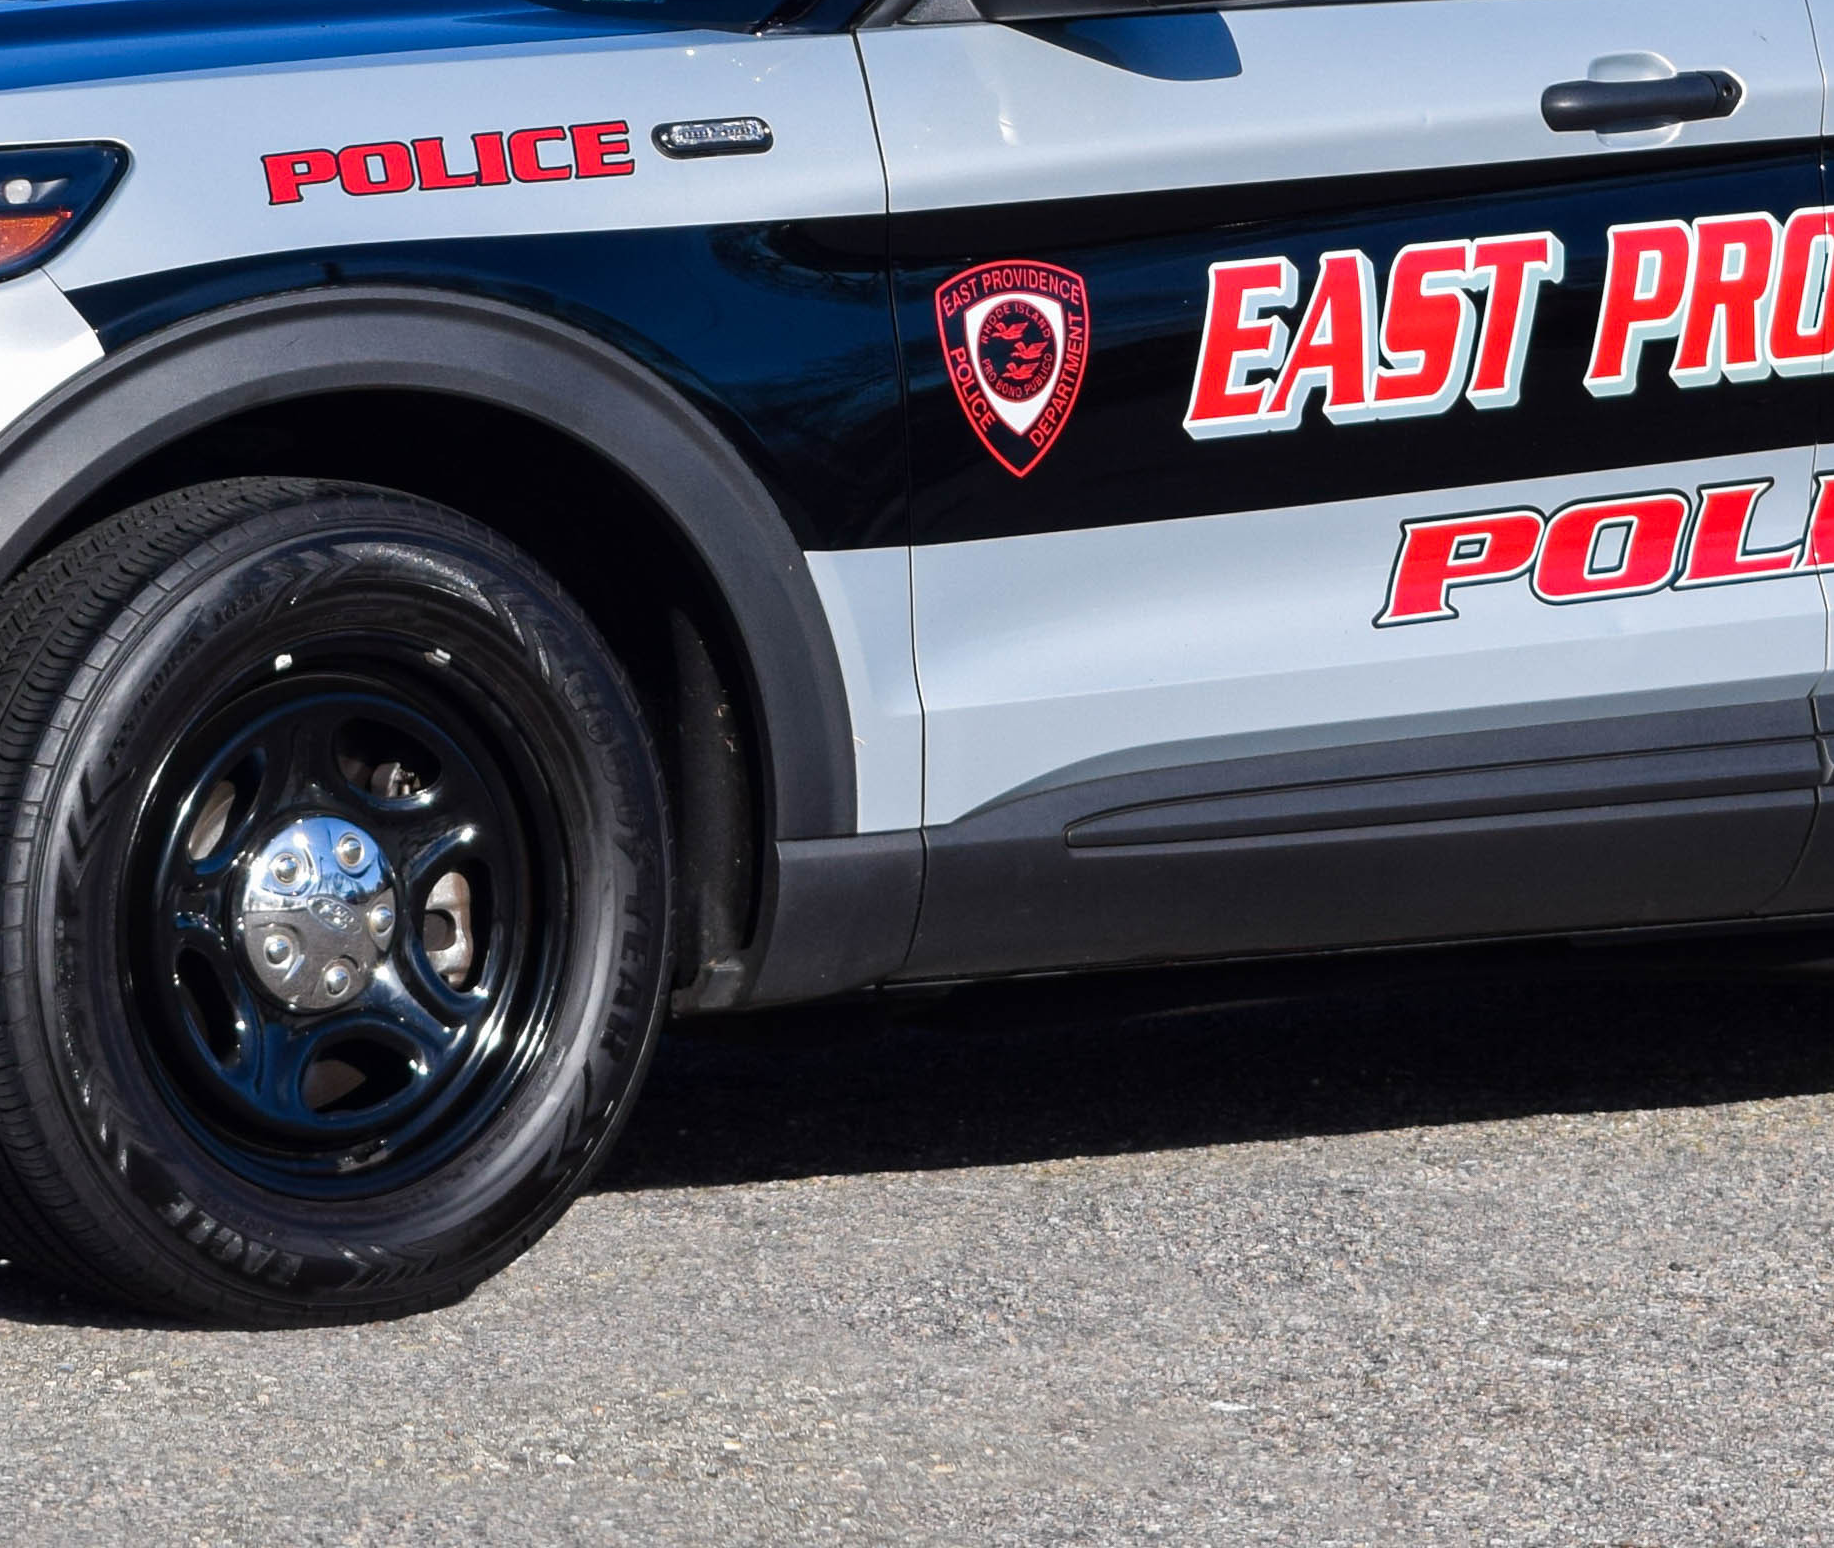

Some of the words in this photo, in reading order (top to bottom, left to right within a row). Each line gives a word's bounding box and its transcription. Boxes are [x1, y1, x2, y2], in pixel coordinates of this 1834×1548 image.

[261, 120, 635, 204] POLICE
[943, 278, 978, 317] EAST
[982, 268, 1081, 305] PROVIDENCE
[981, 304, 1011, 344] RHODE
[1015, 303, 1053, 338] ISLAND
[1182, 231, 1562, 439] EAST
[950, 347, 996, 432] POLICE
[1029, 311, 1083, 448] DEPARTMENT
[982, 358, 996, 381] PRO
[996, 379, 1022, 398] BONO
[1024, 353, 1053, 395] PUBLICO
